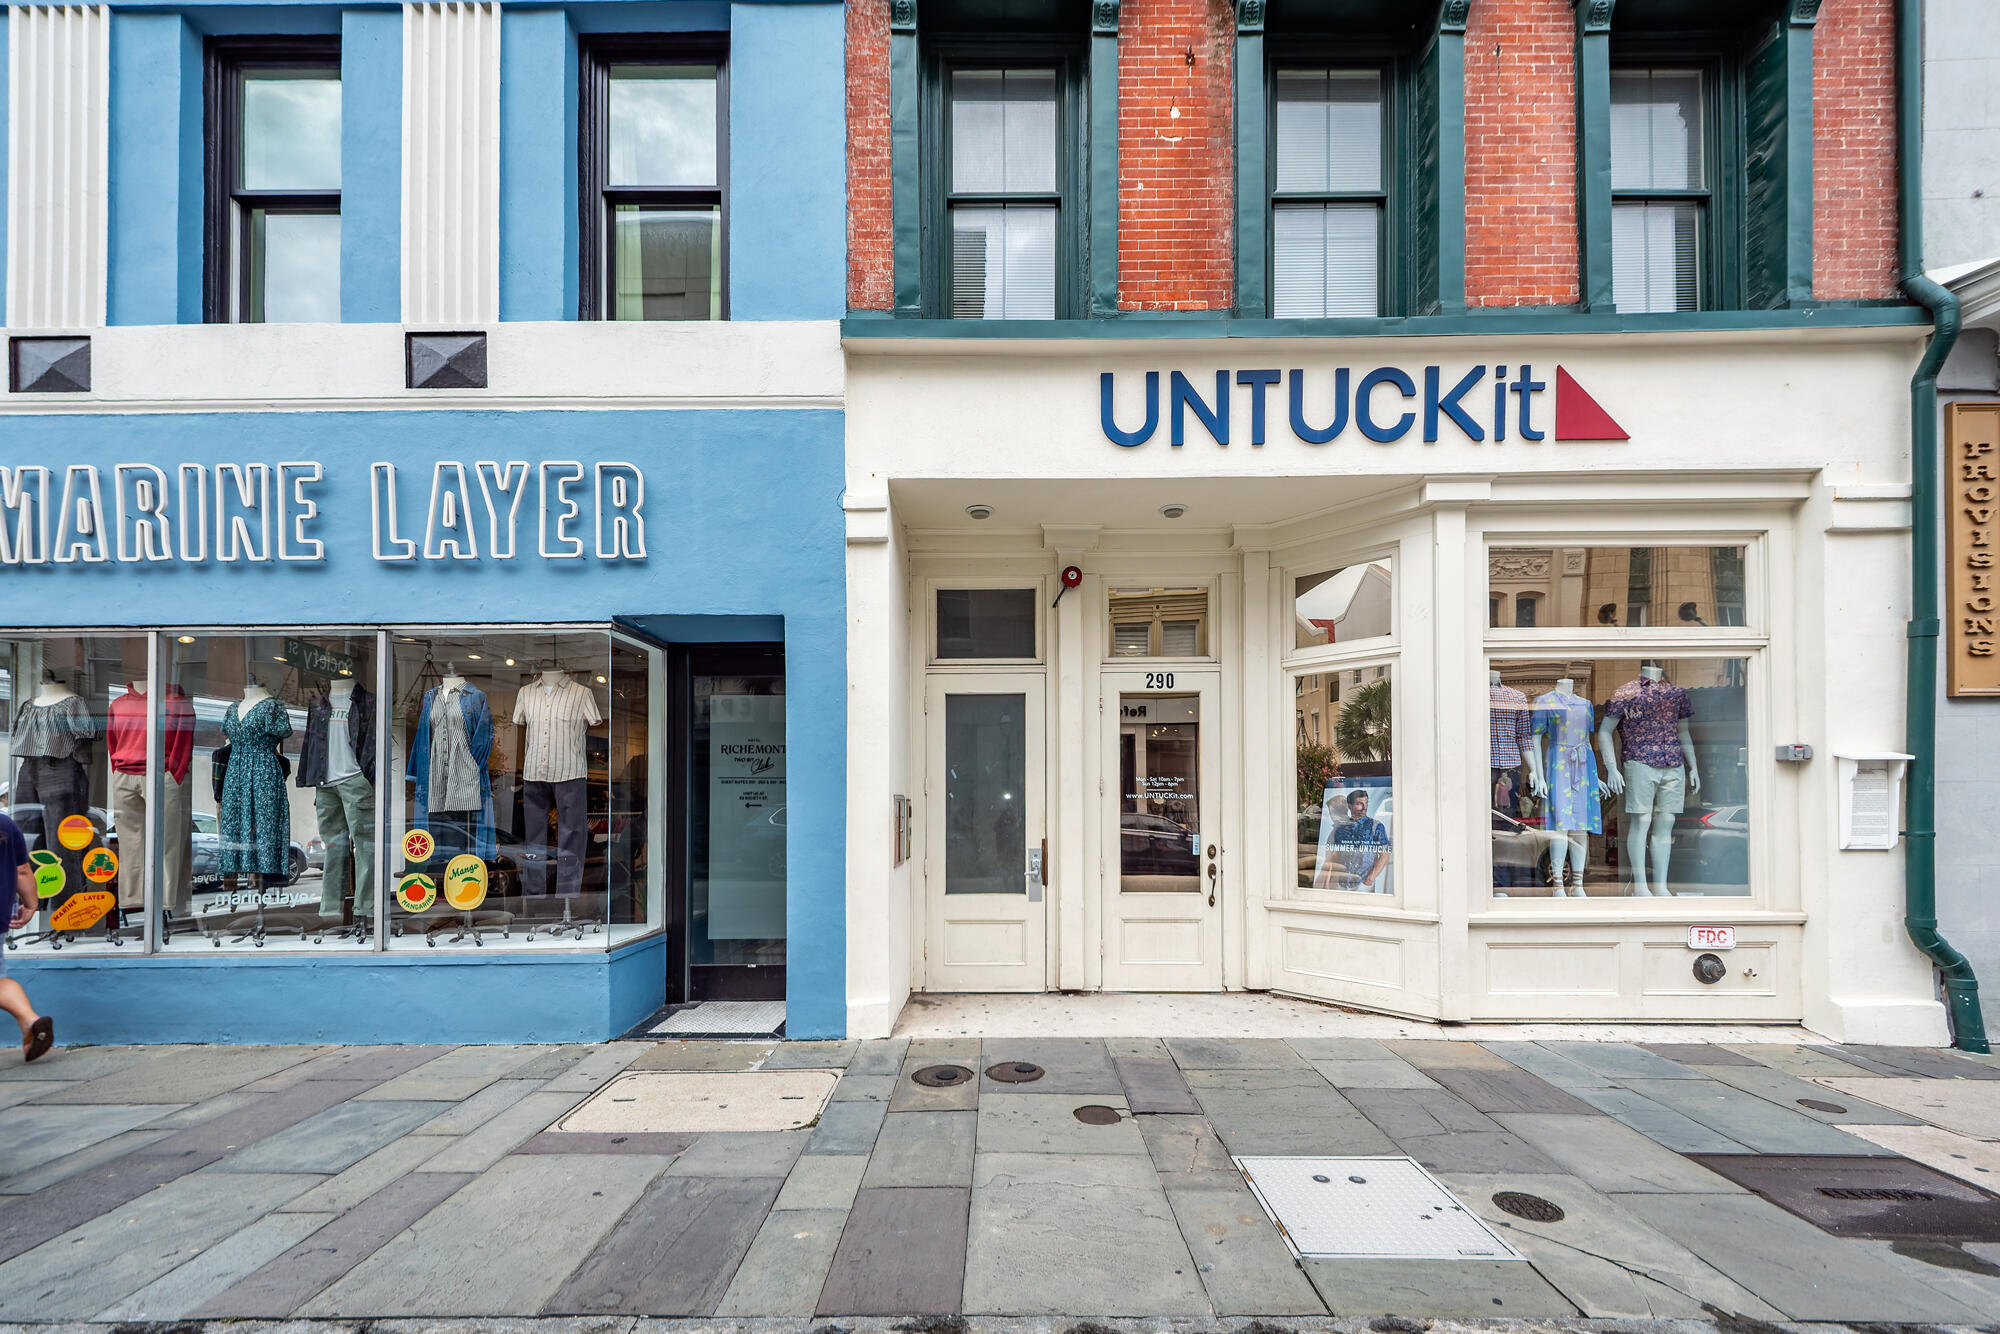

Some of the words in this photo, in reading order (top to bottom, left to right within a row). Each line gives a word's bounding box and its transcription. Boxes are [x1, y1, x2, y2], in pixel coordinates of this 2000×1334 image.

[1100, 364, 1546, 447] UNTUCKit
[0, 462, 325, 564] MARINE
[370, 461, 648, 560] LAYER
[1963, 441, 1997, 658] PROVISIONS
[1145, 673, 1175, 689] 290
[720, 744, 786, 755] RICHEMONT
[40, 874, 59, 884] Lime
[449, 863, 479, 881] Mango
[214, 888, 273, 905] marine
[275, 888, 317, 908] layer
[53, 899, 77, 921] MARINE
[1697, 929, 1728, 944] FDC
